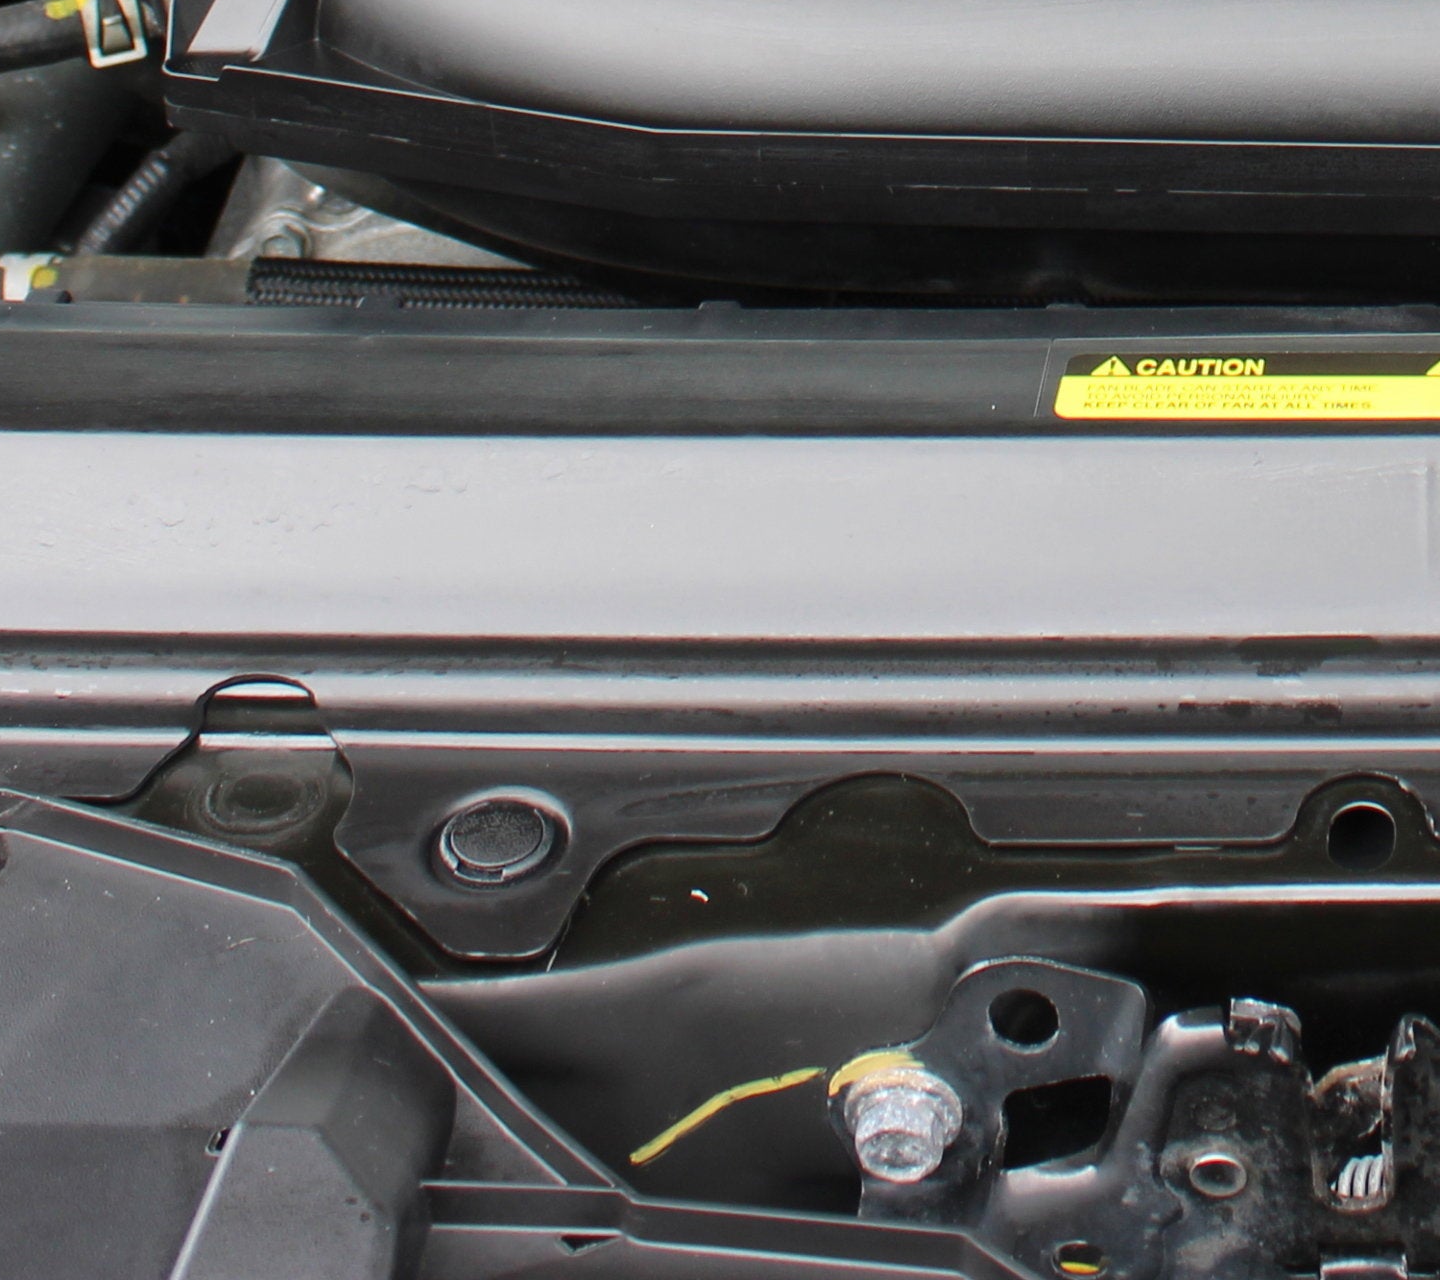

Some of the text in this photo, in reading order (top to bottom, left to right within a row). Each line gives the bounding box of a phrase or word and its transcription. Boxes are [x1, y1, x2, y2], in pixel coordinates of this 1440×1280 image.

[1135, 358, 1266, 376] CAUTION
[1083, 401, 1128, 410] KEEP
[1133, 401, 1189, 410] CLEAR
[1222, 401, 1255, 410] FAN
[1284, 401, 1316, 410] ALL
